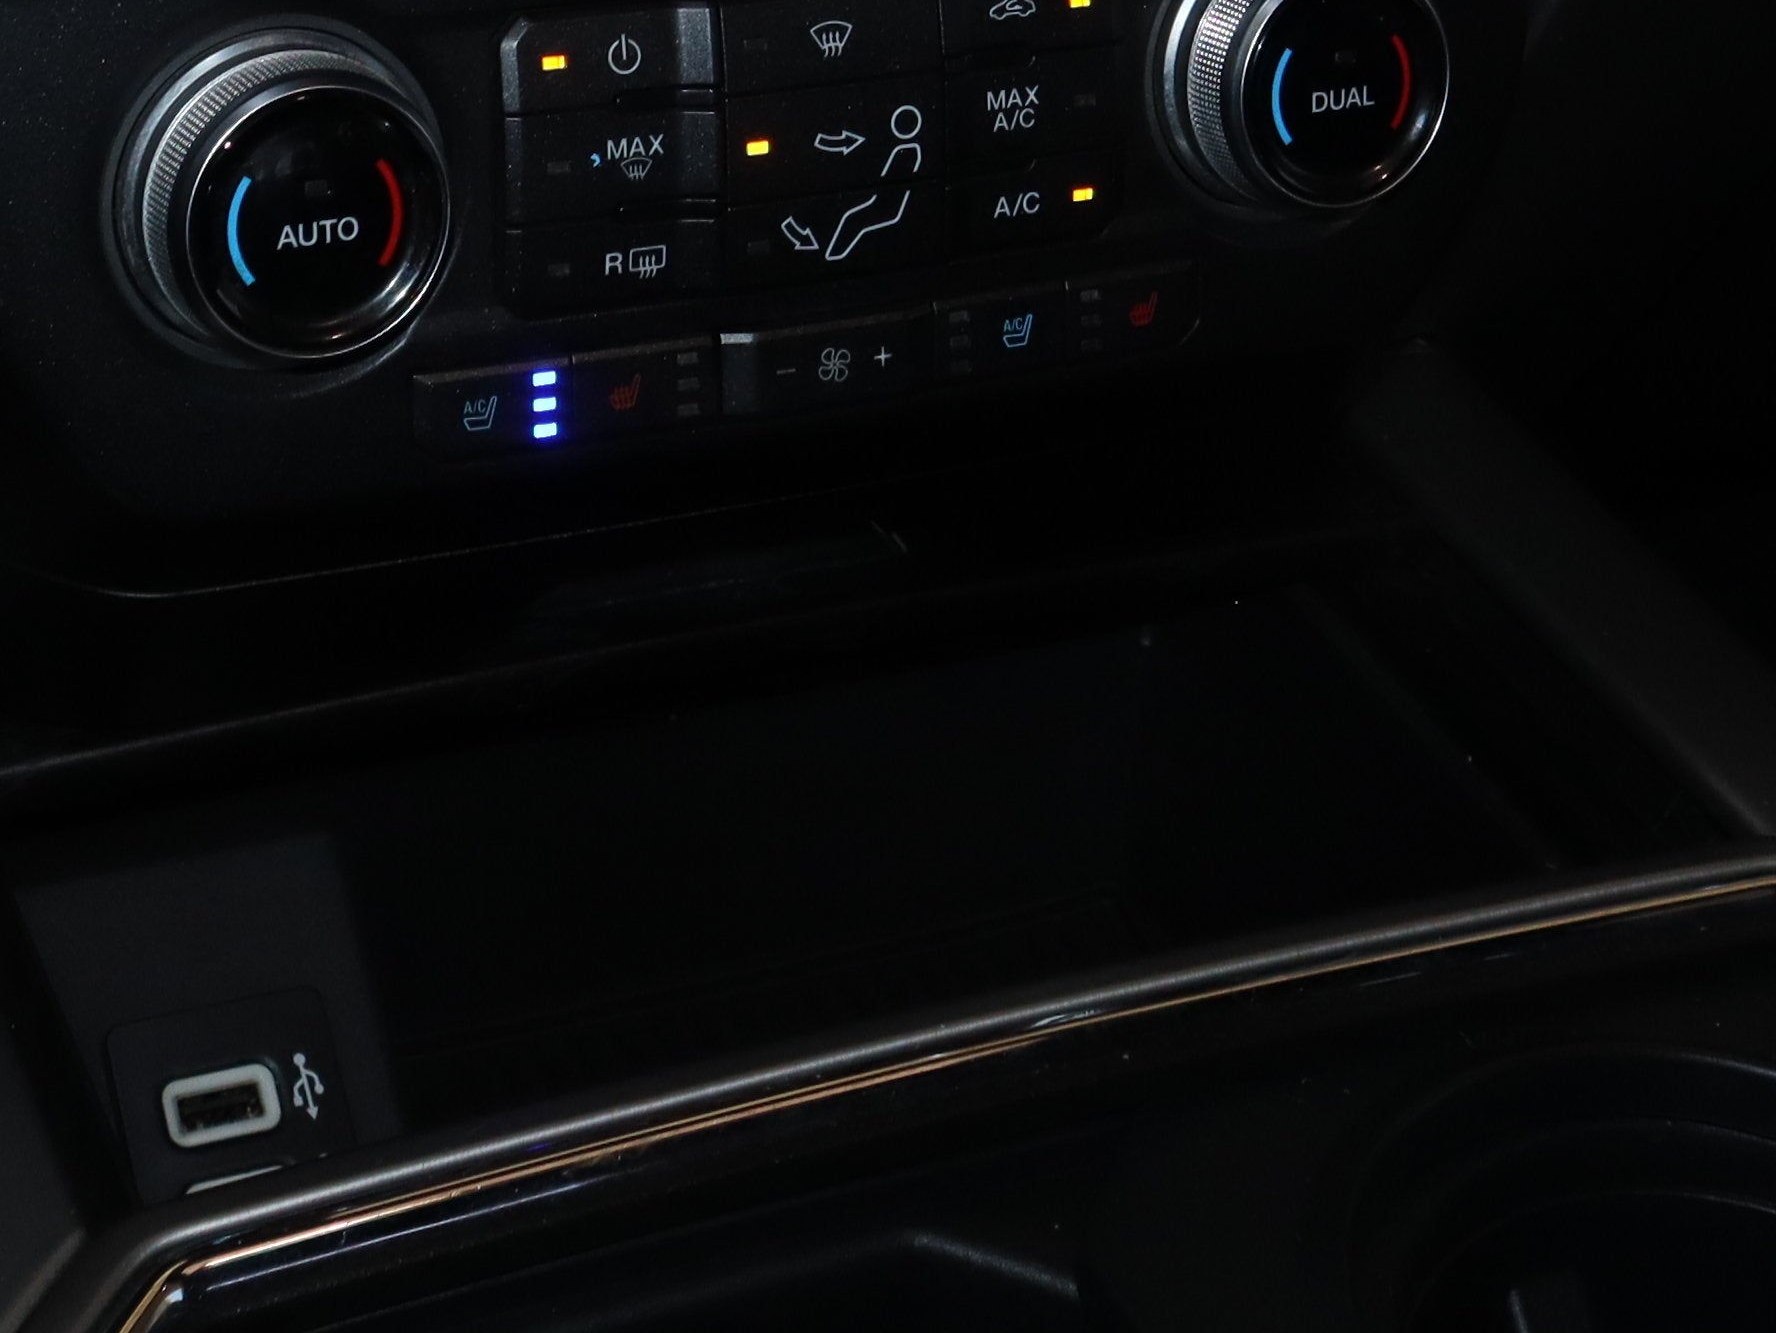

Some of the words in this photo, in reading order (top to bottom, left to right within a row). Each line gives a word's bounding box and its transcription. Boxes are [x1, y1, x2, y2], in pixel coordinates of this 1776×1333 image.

[986, 85, 1039, 110] MAX
[1311, 85, 1375, 113] DUAL
[993, 107, 1035, 132] A/C
[606, 133, 664, 160] MAX
[993, 191, 1040, 219] A/C
[277, 216, 359, 250] AUTO
[604, 252, 623, 276] R
